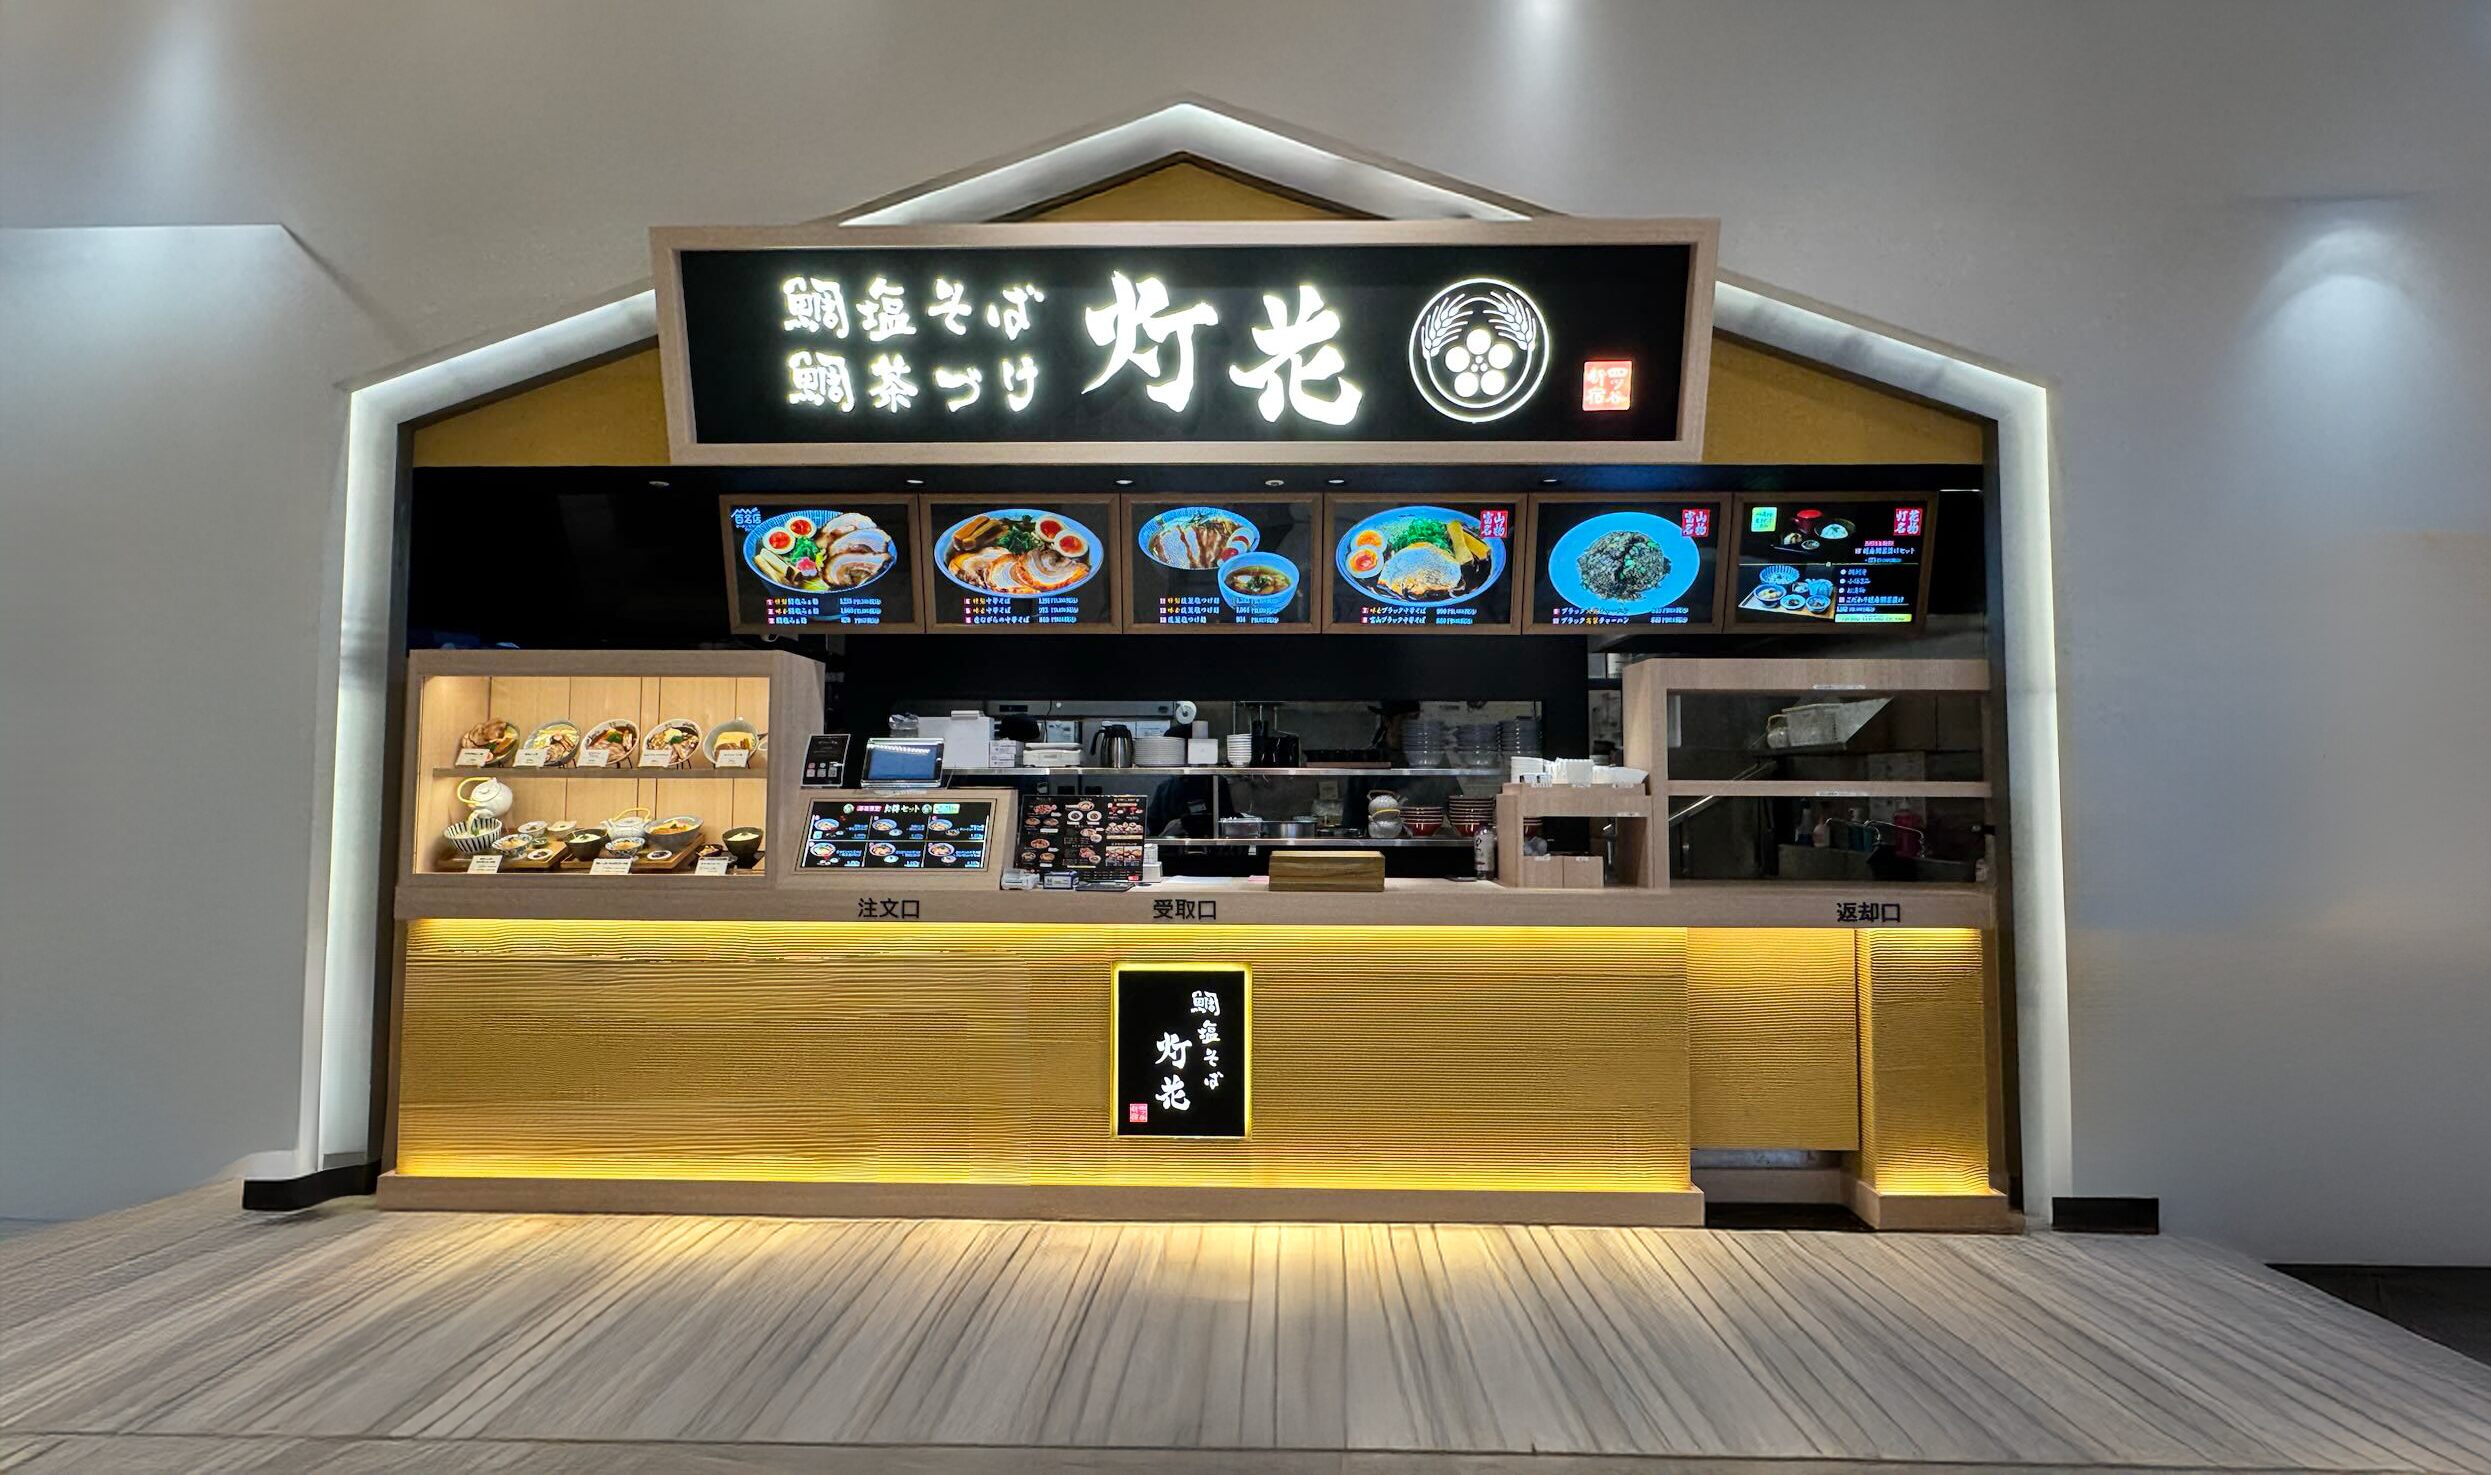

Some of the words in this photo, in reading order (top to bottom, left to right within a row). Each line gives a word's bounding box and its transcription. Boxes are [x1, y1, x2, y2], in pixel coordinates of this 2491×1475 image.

[783, 276, 1046, 341] 鯛塩そば
[1081, 270, 1364, 426] 灯花
[788, 351, 1039, 412] 鯛茶づけ
[858, 898, 919, 919] 注文口
[1153, 898, 1217, 920] 受取口
[1837, 902, 1900, 922] 返却口
[1155, 1031, 1193, 1111] 灯花
[1190, 990, 1224, 1090] 鯛塩そば
